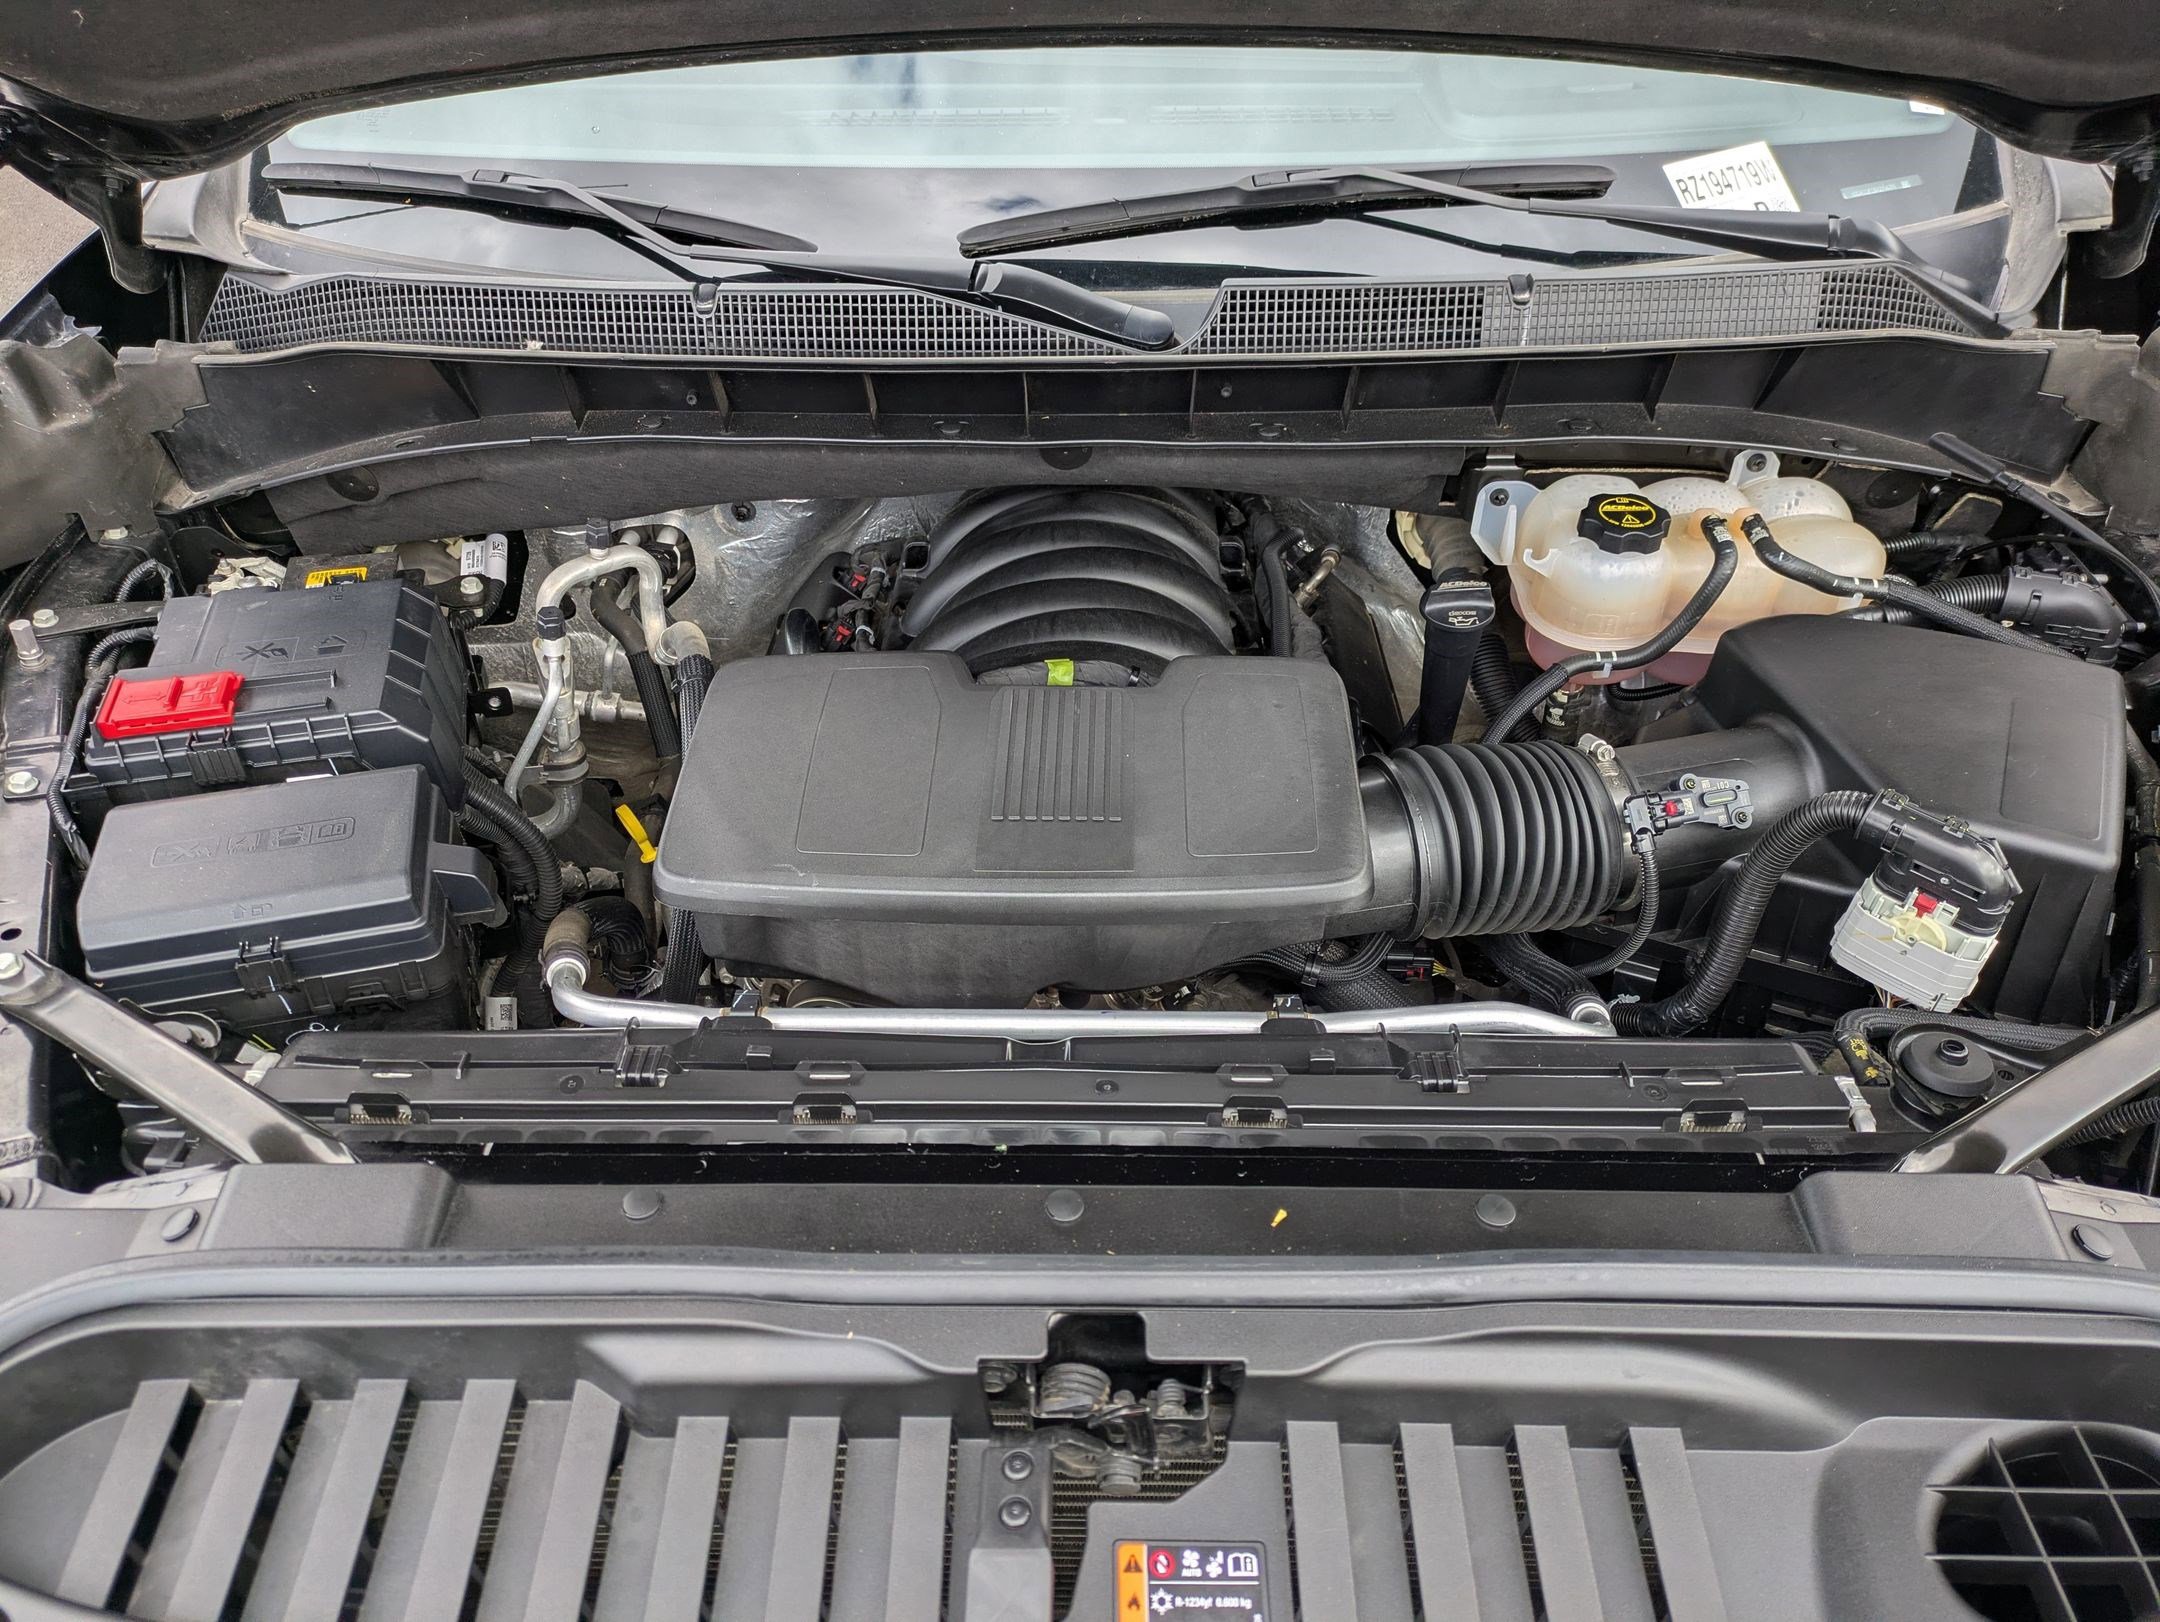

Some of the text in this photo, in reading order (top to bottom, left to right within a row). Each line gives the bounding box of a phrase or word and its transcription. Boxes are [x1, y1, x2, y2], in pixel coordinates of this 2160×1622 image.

[1601, 504, 1649, 512] ACDelco
[1439, 580, 1488, 589] ACDelco
[1181, 1567, 1203, 1578] AUTO
[1240, 1597, 1252, 1609] kg
